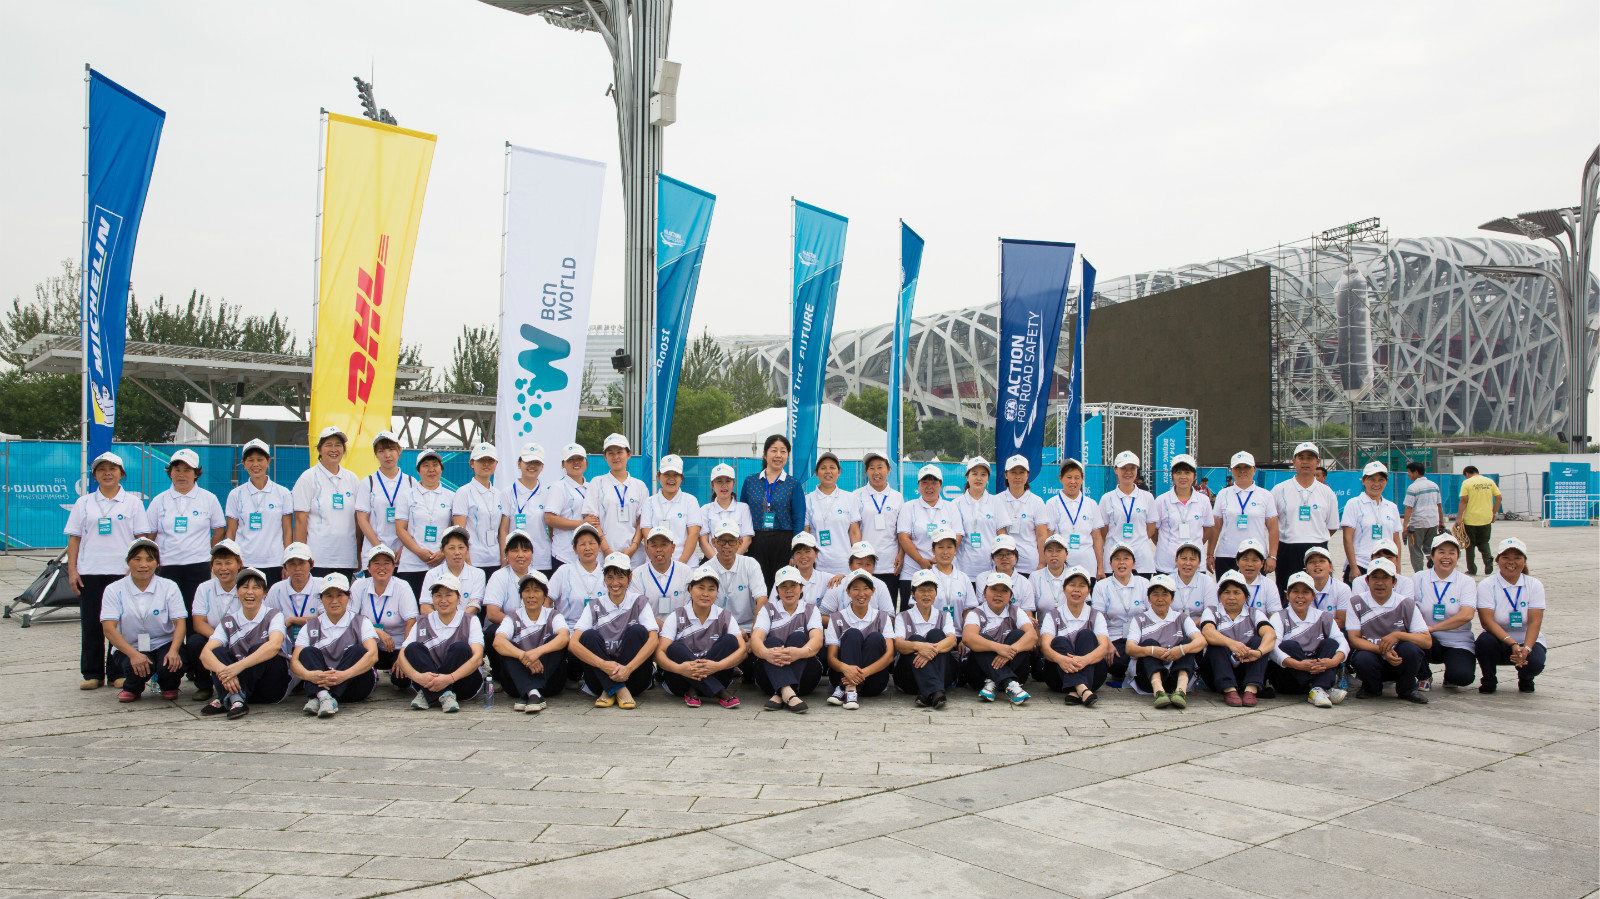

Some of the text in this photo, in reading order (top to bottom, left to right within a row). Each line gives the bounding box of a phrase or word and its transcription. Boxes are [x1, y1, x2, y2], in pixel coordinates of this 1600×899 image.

[90, 216, 110, 377] MICHELIN
[348, 260, 385, 405] DHL
[800, 302, 814, 360] FUTURE
[1007, 335, 1025, 396] ACTION
[1017, 311, 1040, 422] FOR ROAD SAFETY
